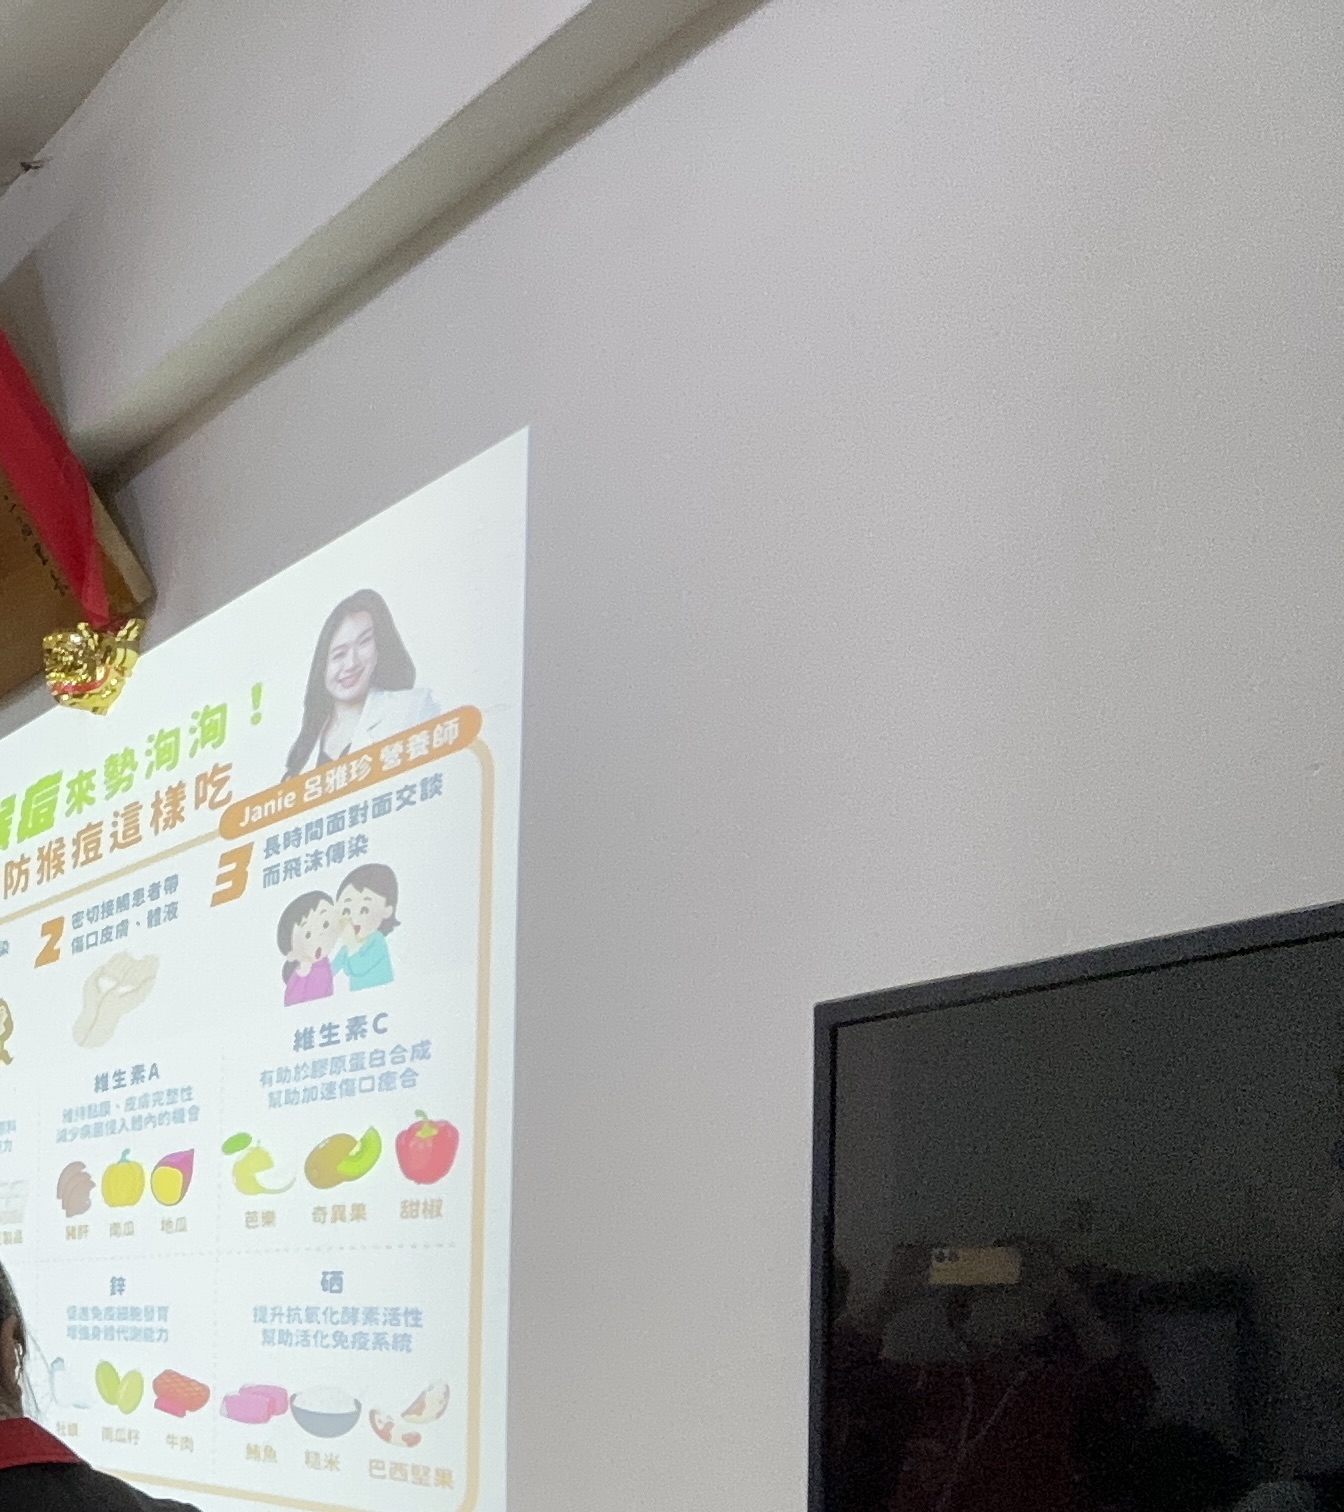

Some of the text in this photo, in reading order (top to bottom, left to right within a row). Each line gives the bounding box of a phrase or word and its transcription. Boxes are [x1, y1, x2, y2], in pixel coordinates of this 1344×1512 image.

[239, 717, 460, 828] Janie 呂雅珍 營養師
[263, 772, 444, 860] 長時間面對面交談
[210, 841, 255, 908] 3
[262, 834, 369, 889] 而飛沫傳染
[34, 916, 65, 969] 2
[292, 1012, 389, 1053] 維生素C
[94, 1063, 160, 1093] 維生素A
[259, 1039, 432, 1088] 有助於膠原蛋白合成
[244, 1210, 277, 1230] 芭樂
[312, 1203, 368, 1225] 奇異果
[399, 1198, 444, 1220] 甜椒
[321, 1270, 345, 1294] 硒
[253, 1305, 424, 1328] 提升抗氧化酵素活性
[262, 1328, 413, 1353] 幫助活化免疫系統
[369, 1458, 455, 1489] 巴西堅果
